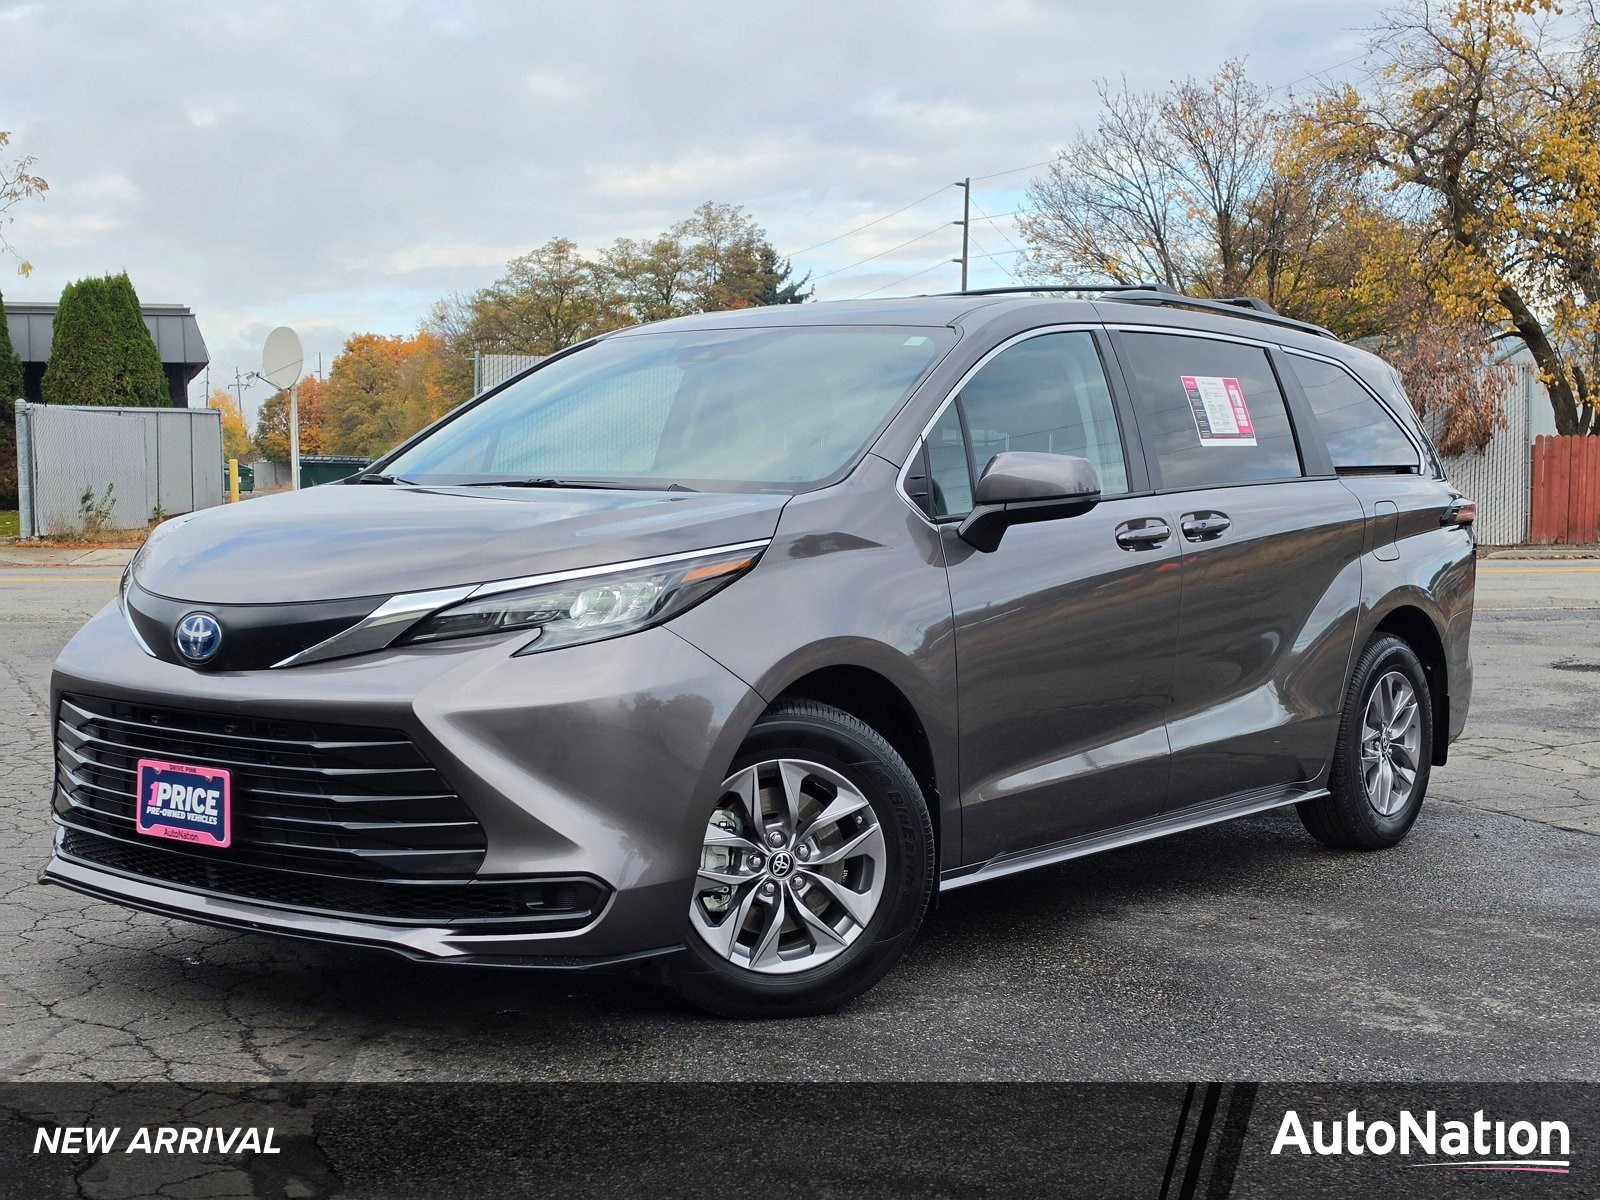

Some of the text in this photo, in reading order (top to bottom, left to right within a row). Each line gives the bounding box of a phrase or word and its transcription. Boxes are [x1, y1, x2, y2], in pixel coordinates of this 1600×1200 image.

[169, 764, 185, 773] DRIVE
[146, 806, 218, 825] PRE-OWNED VEHICLES
[163, 828, 199, 841] AutoNation
